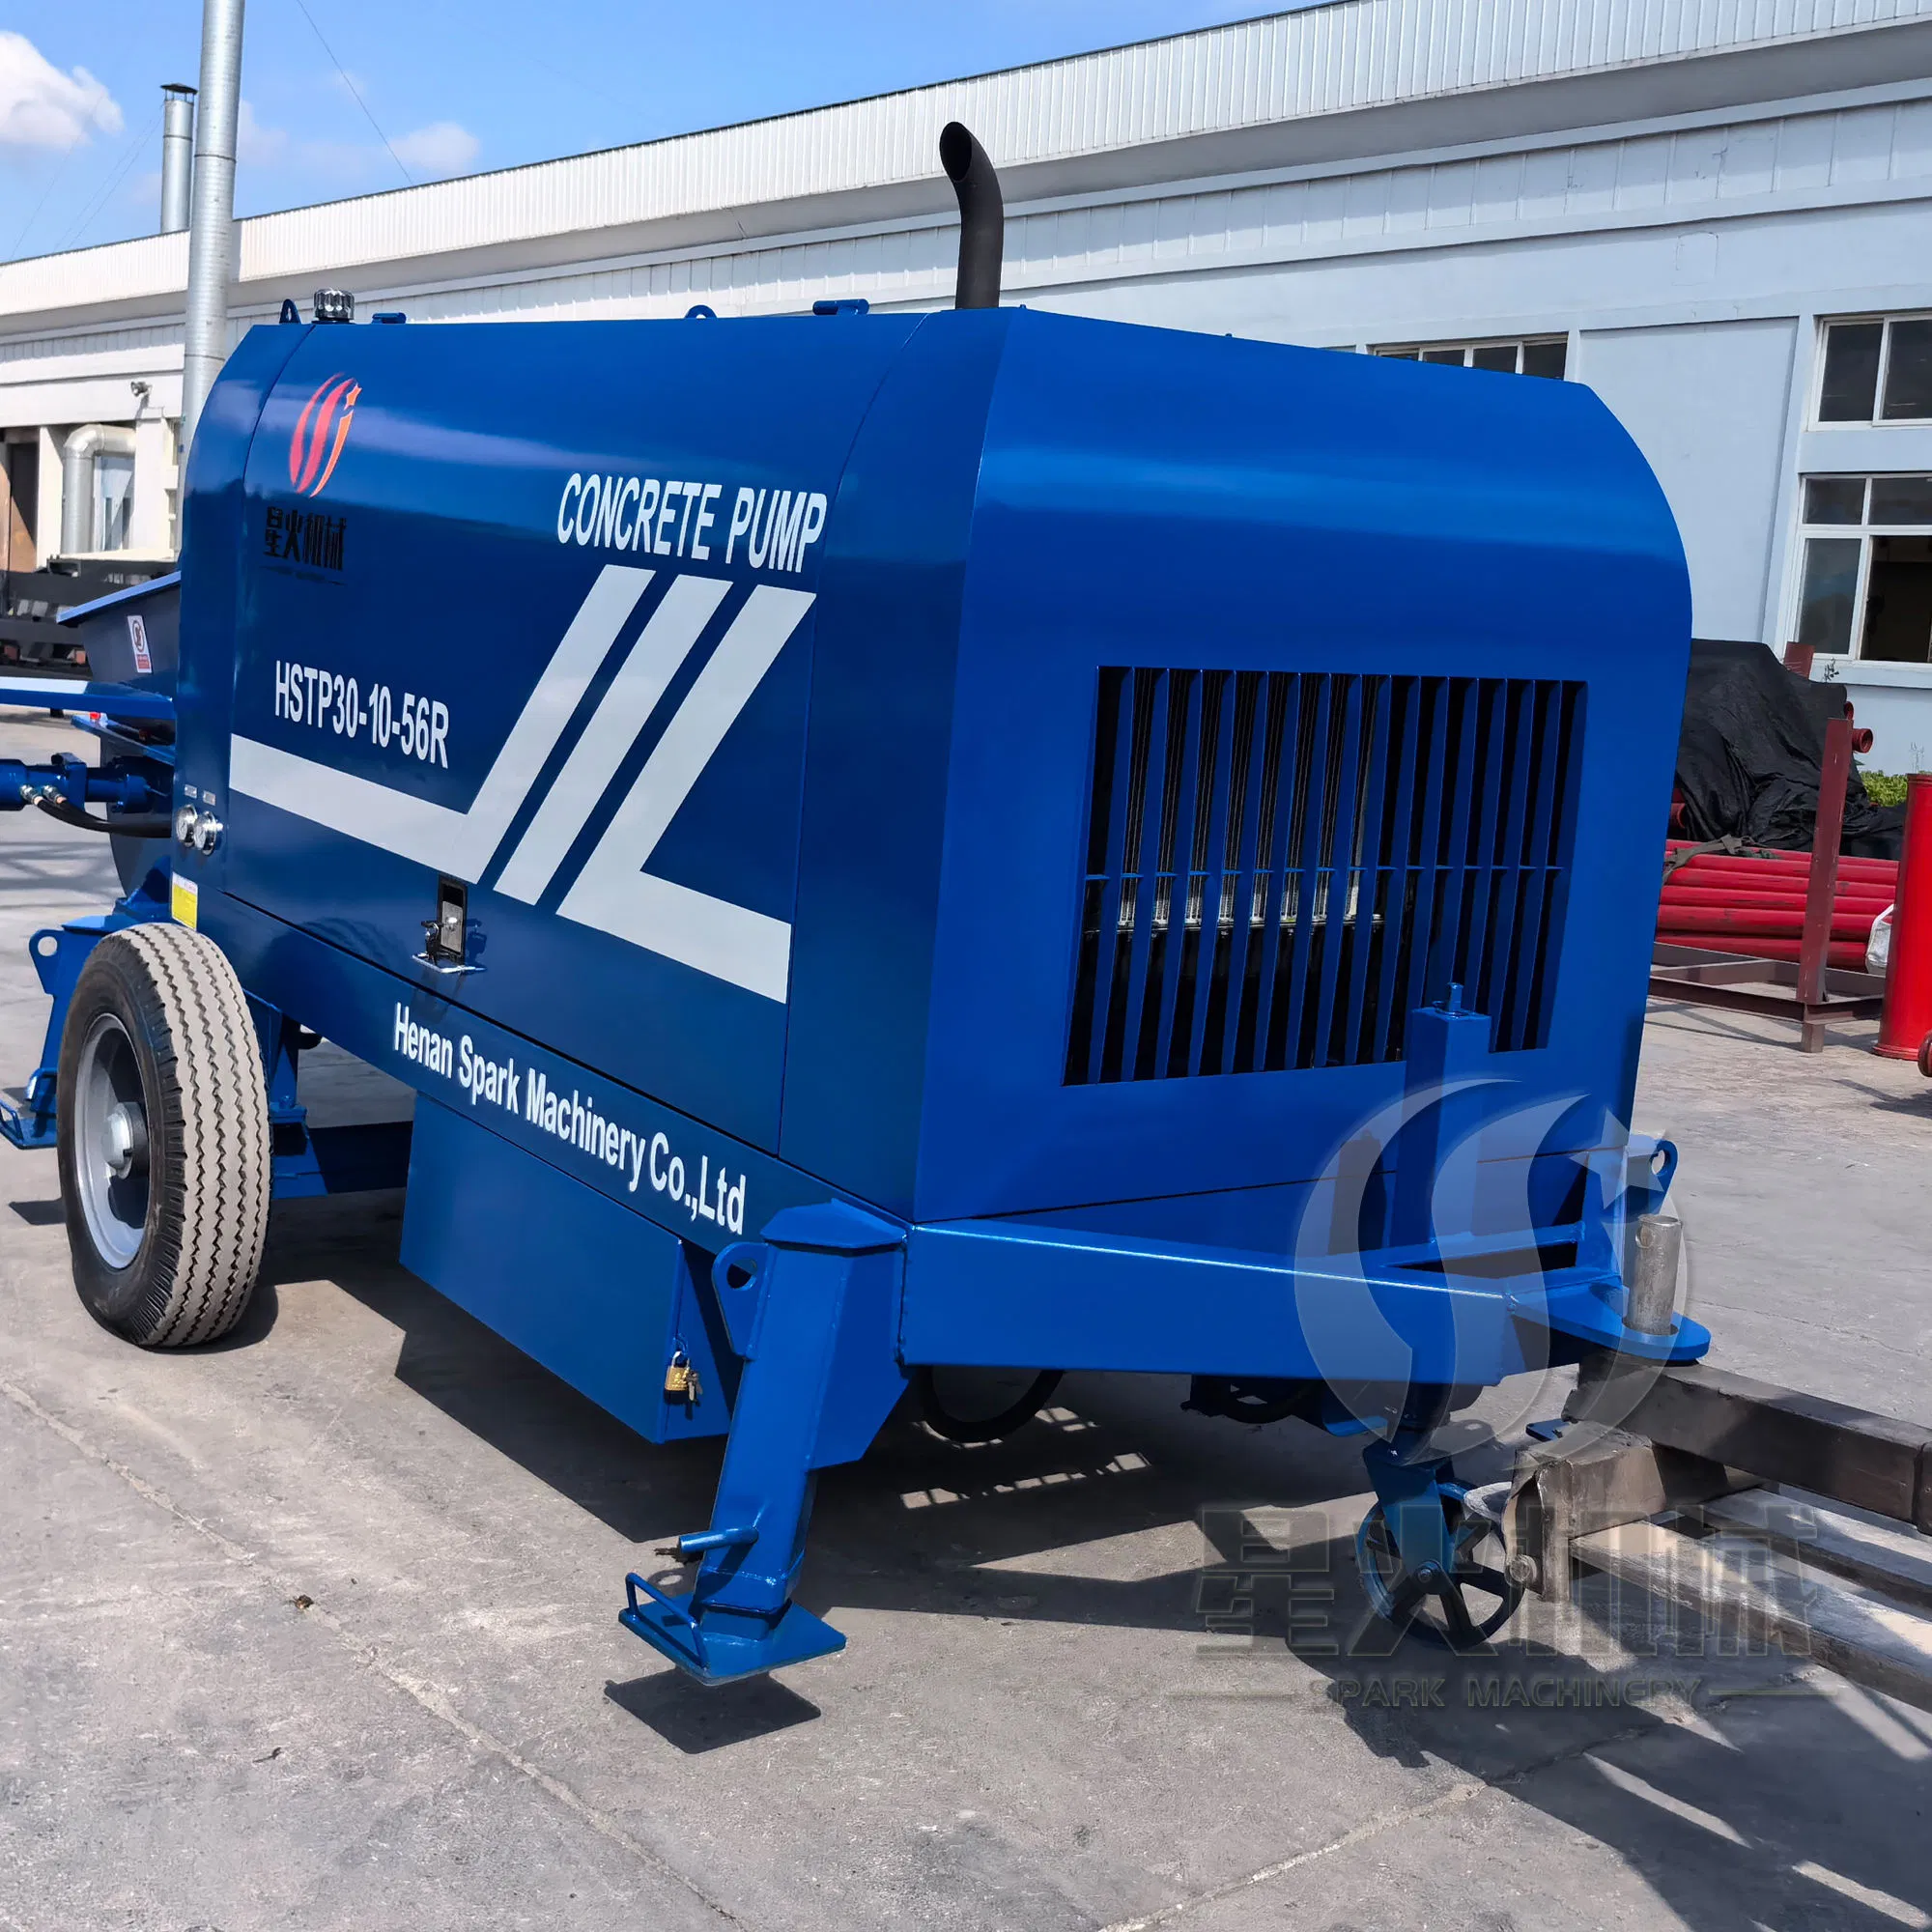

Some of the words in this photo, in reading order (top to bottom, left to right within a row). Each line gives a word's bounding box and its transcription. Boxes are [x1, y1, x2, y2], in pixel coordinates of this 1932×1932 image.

[557, 472, 722, 560] CONCRETE
[725, 487, 827, 573] PUMP
[275, 660, 449, 769] HSTP30-10-56R
[393, 1002, 452, 1079] Henan
[458, 1035, 519, 1115] Spark
[526, 1067, 646, 1193] Machinery
[649, 1132, 747, 1235] Co.,Ltd
